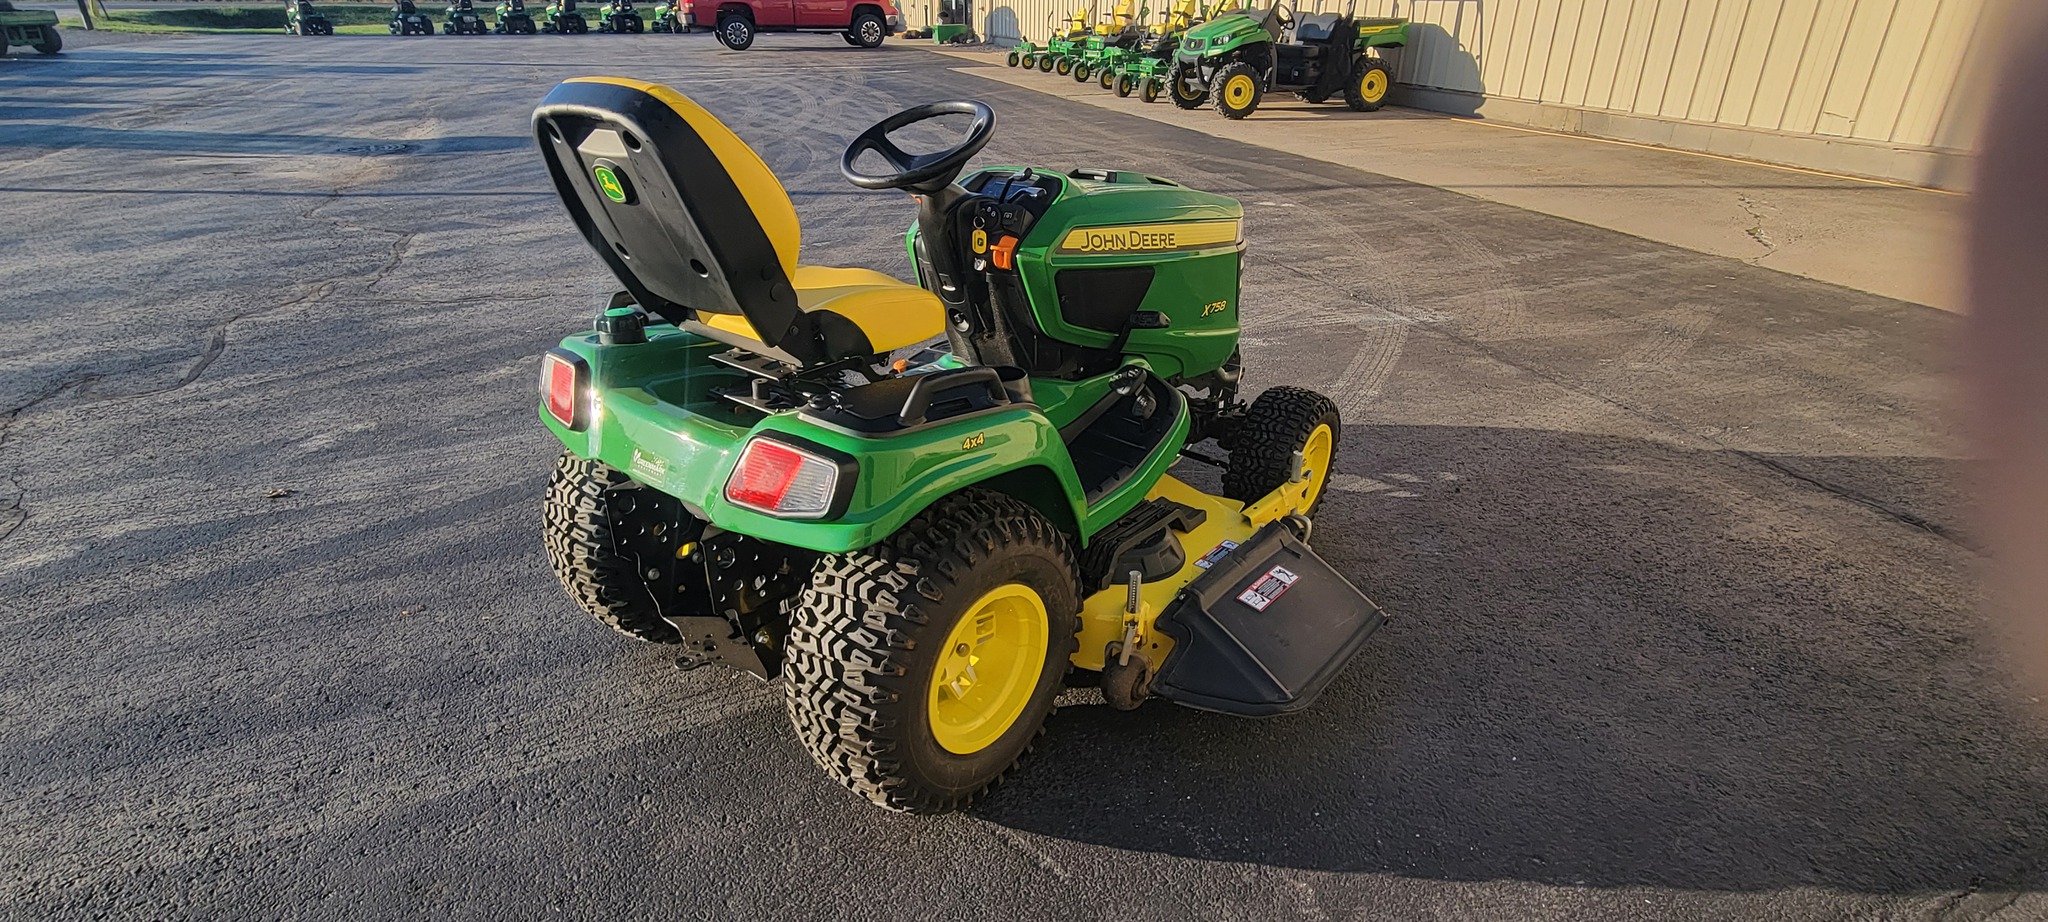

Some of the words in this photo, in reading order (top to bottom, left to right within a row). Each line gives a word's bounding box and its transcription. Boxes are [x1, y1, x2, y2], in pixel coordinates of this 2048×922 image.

[1081, 231, 1127, 250] JOHN
[1129, 230, 1176, 248] DEERE
[1200, 299, 1227, 318] X758
[962, 432, 985, 450] 4x4
